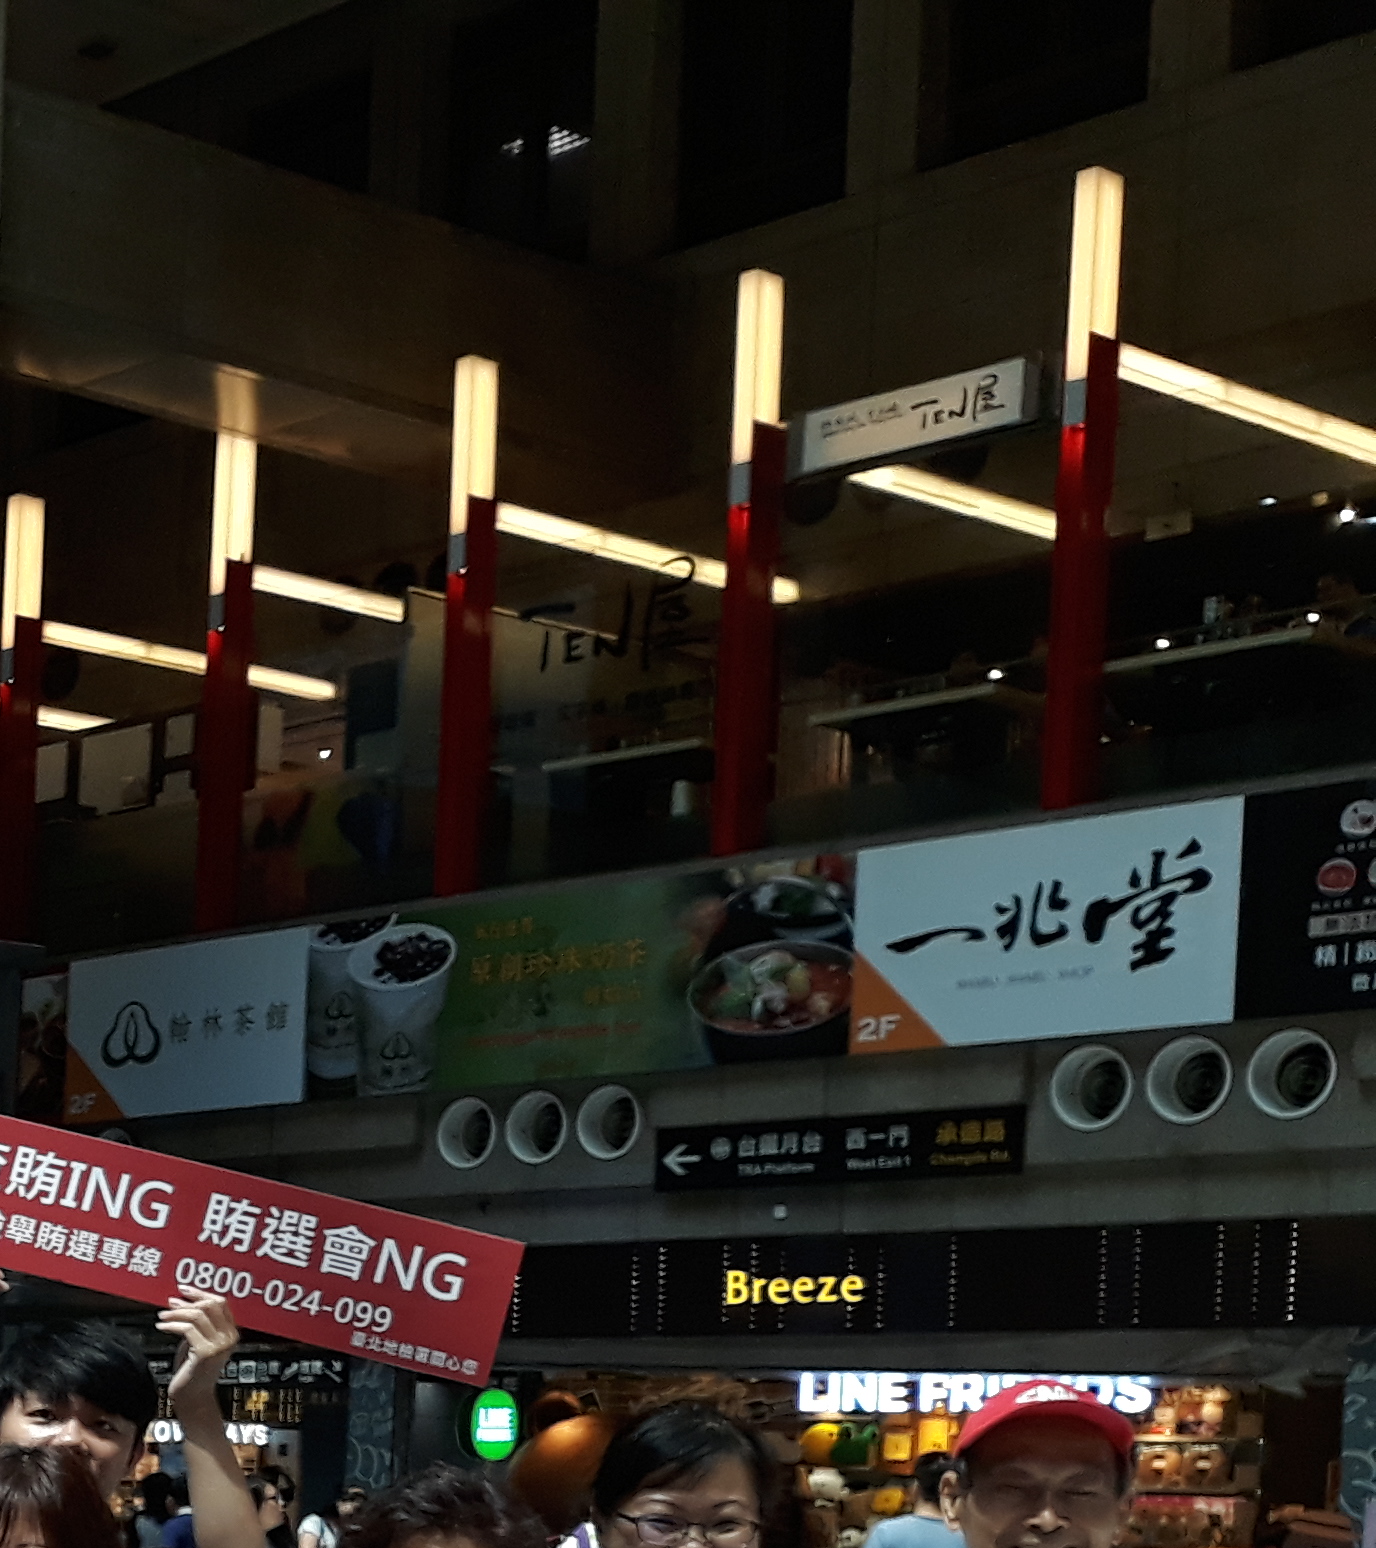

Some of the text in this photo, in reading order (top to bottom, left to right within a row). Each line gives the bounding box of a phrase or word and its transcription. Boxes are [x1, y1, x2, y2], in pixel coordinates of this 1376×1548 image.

[855, 1013, 902, 1044] 2F
[197, 1191, 469, 1302] 賄選會NG
[175, 1256, 394, 1333] 0800-024-099
[725, 1268, 866, 1306] Breeze
[798, 1371, 911, 1414] LINE
[918, 1372, 1153, 1415] FRIDS
